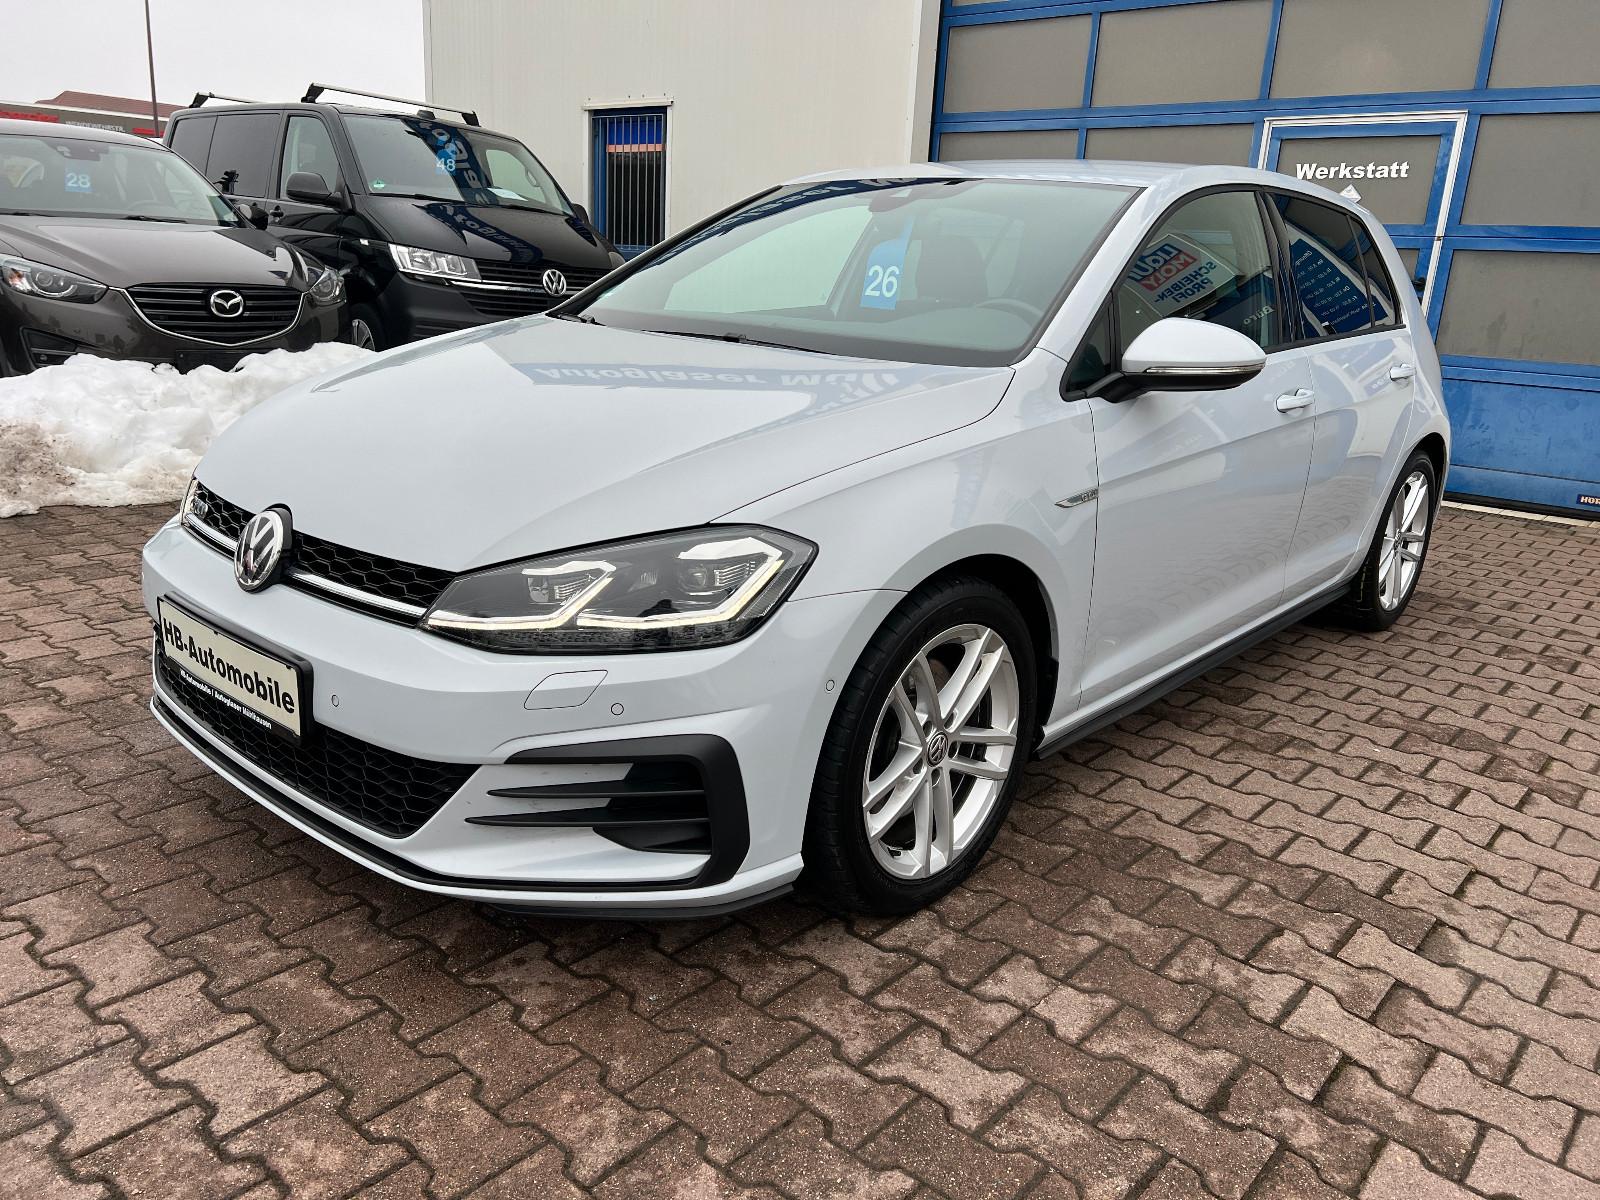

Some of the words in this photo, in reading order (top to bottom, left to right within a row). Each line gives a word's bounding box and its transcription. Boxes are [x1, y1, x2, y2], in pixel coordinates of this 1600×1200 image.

[436, 157, 456, 171] 48
[1296, 161, 1410, 180] Werkstatt
[66, 172, 91, 188] 28
[864, 264, 900, 298] 26
[163, 617, 295, 714] HB-Automobile
